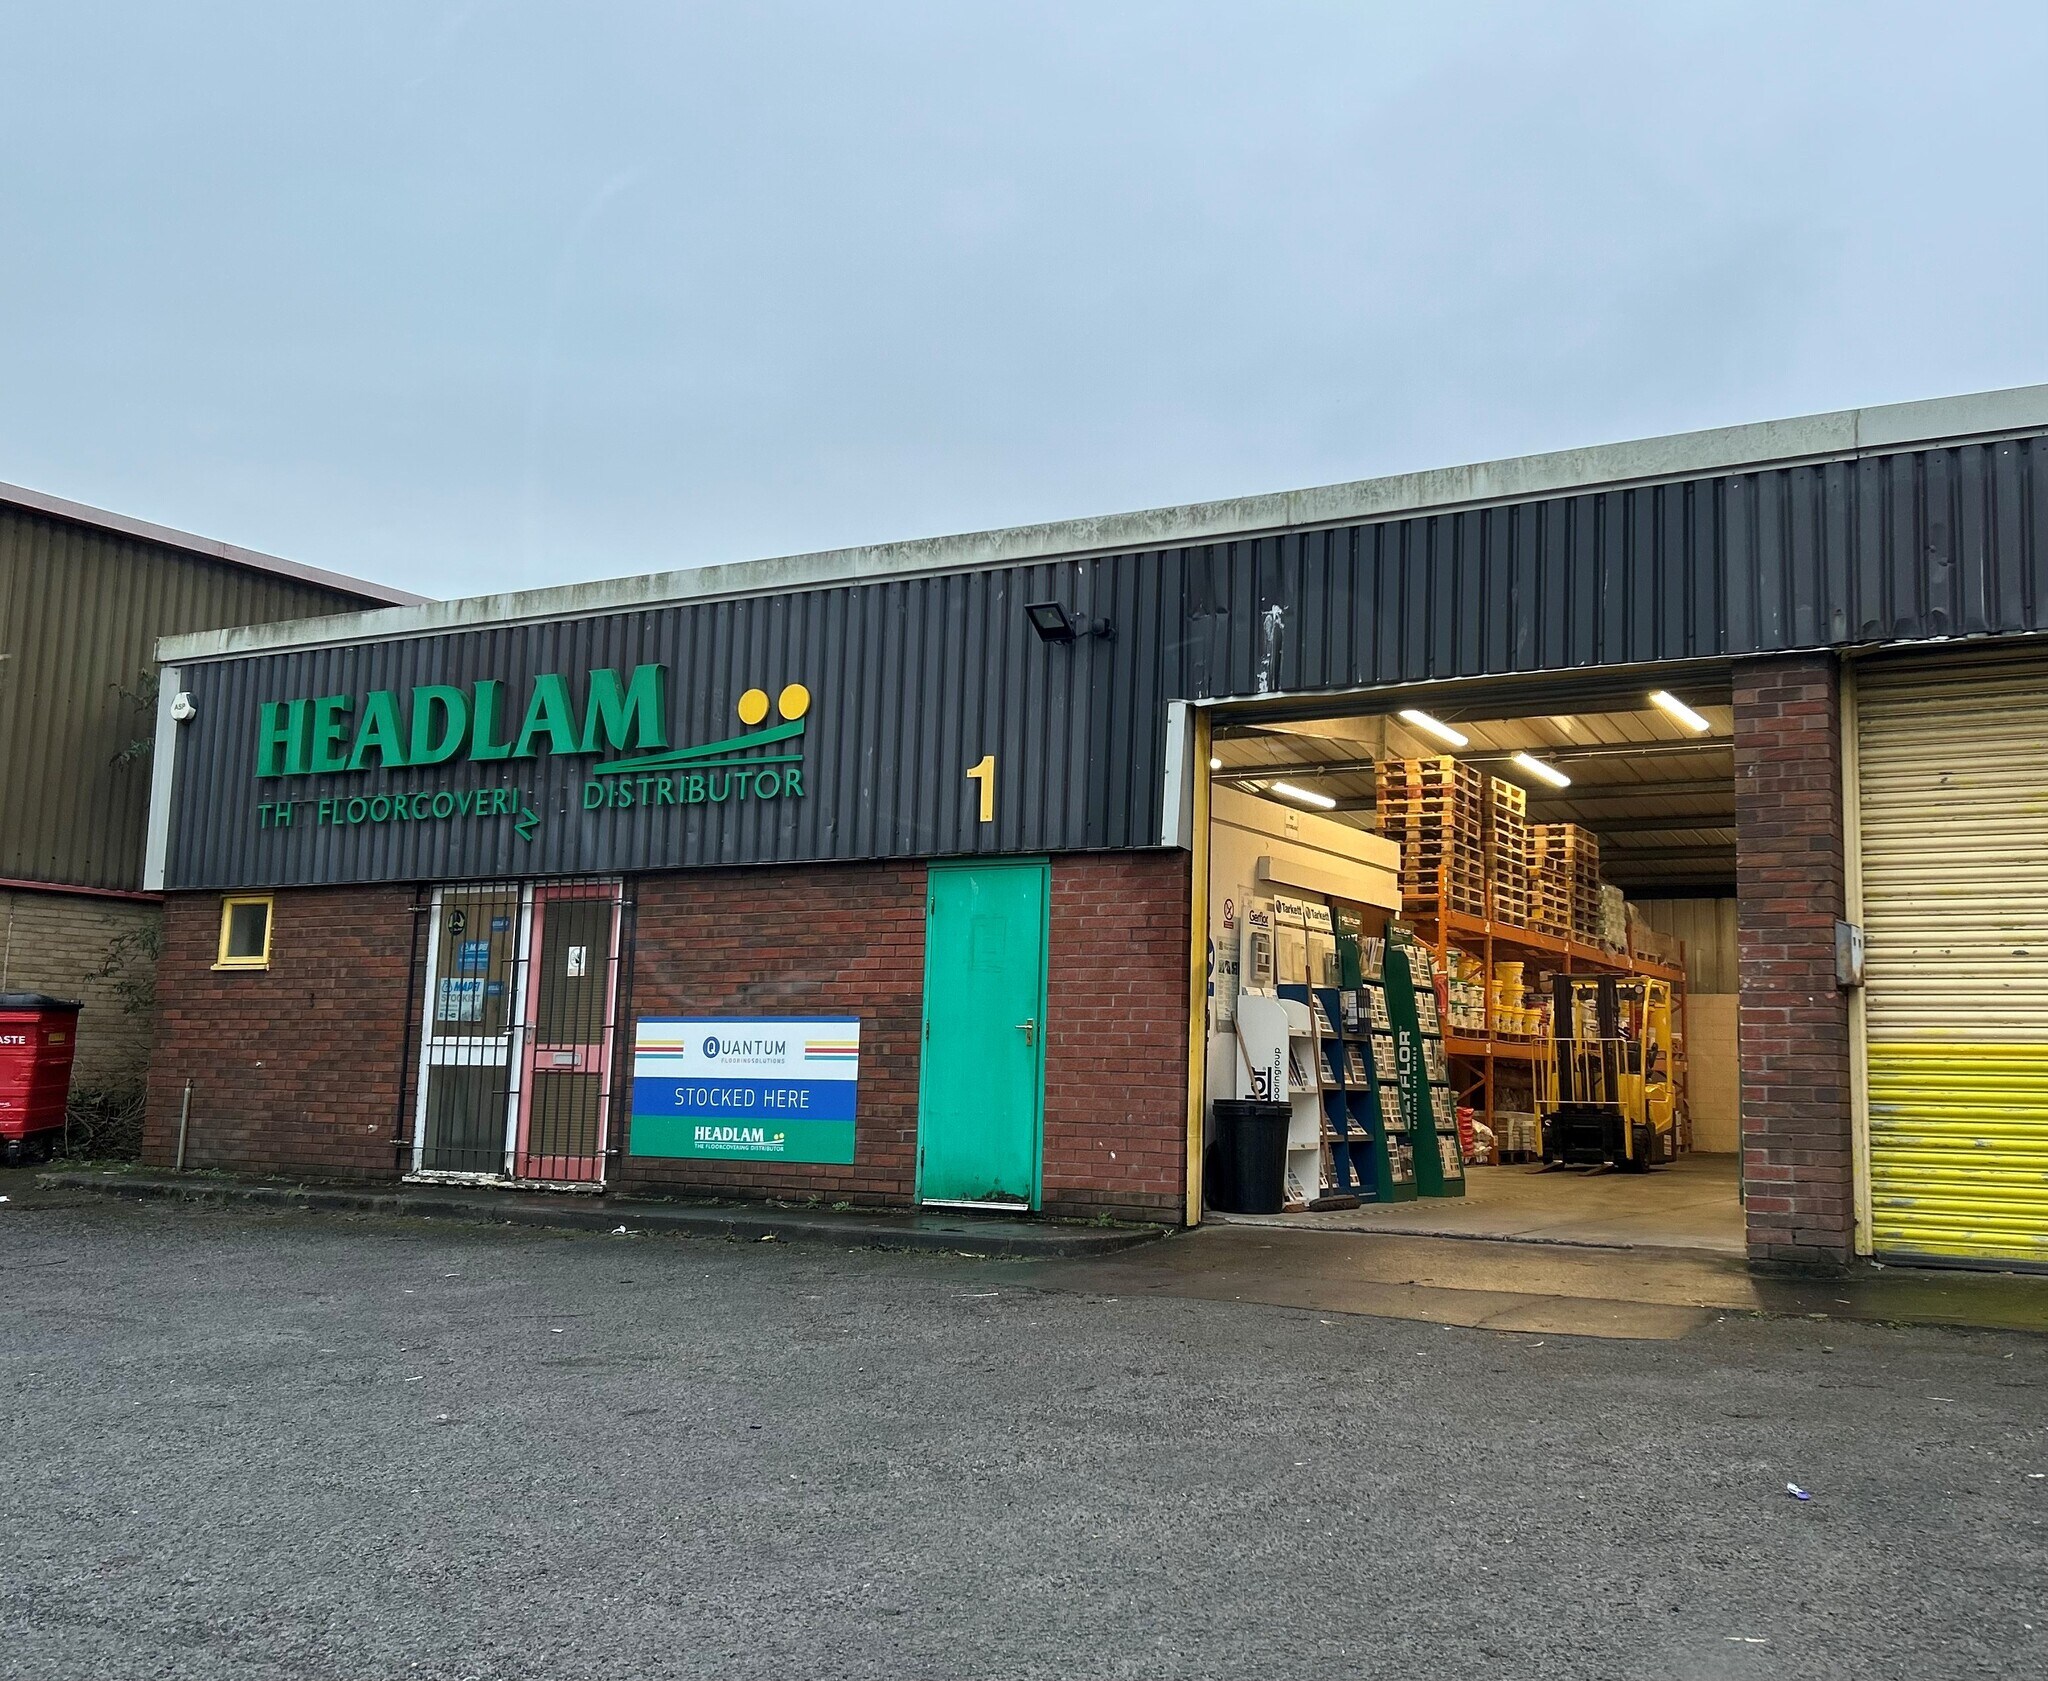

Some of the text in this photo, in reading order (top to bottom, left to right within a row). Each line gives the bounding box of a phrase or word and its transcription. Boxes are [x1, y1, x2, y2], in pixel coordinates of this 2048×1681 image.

[254, 663, 670, 778] HEADLAM
[257, 801, 293, 829] TH
[583, 768, 805, 811] DISTRIBUTOR
[966, 755, 995, 822] 1
[1281, 902, 1303, 916] Tarkett
[1310, 908, 1330, 921] Tarkett
[703, 1036, 787, 1059] QUANTUM
[674, 1087, 810, 1109] STOCKED HERE
[694, 1125, 765, 1143] HEADLAM
